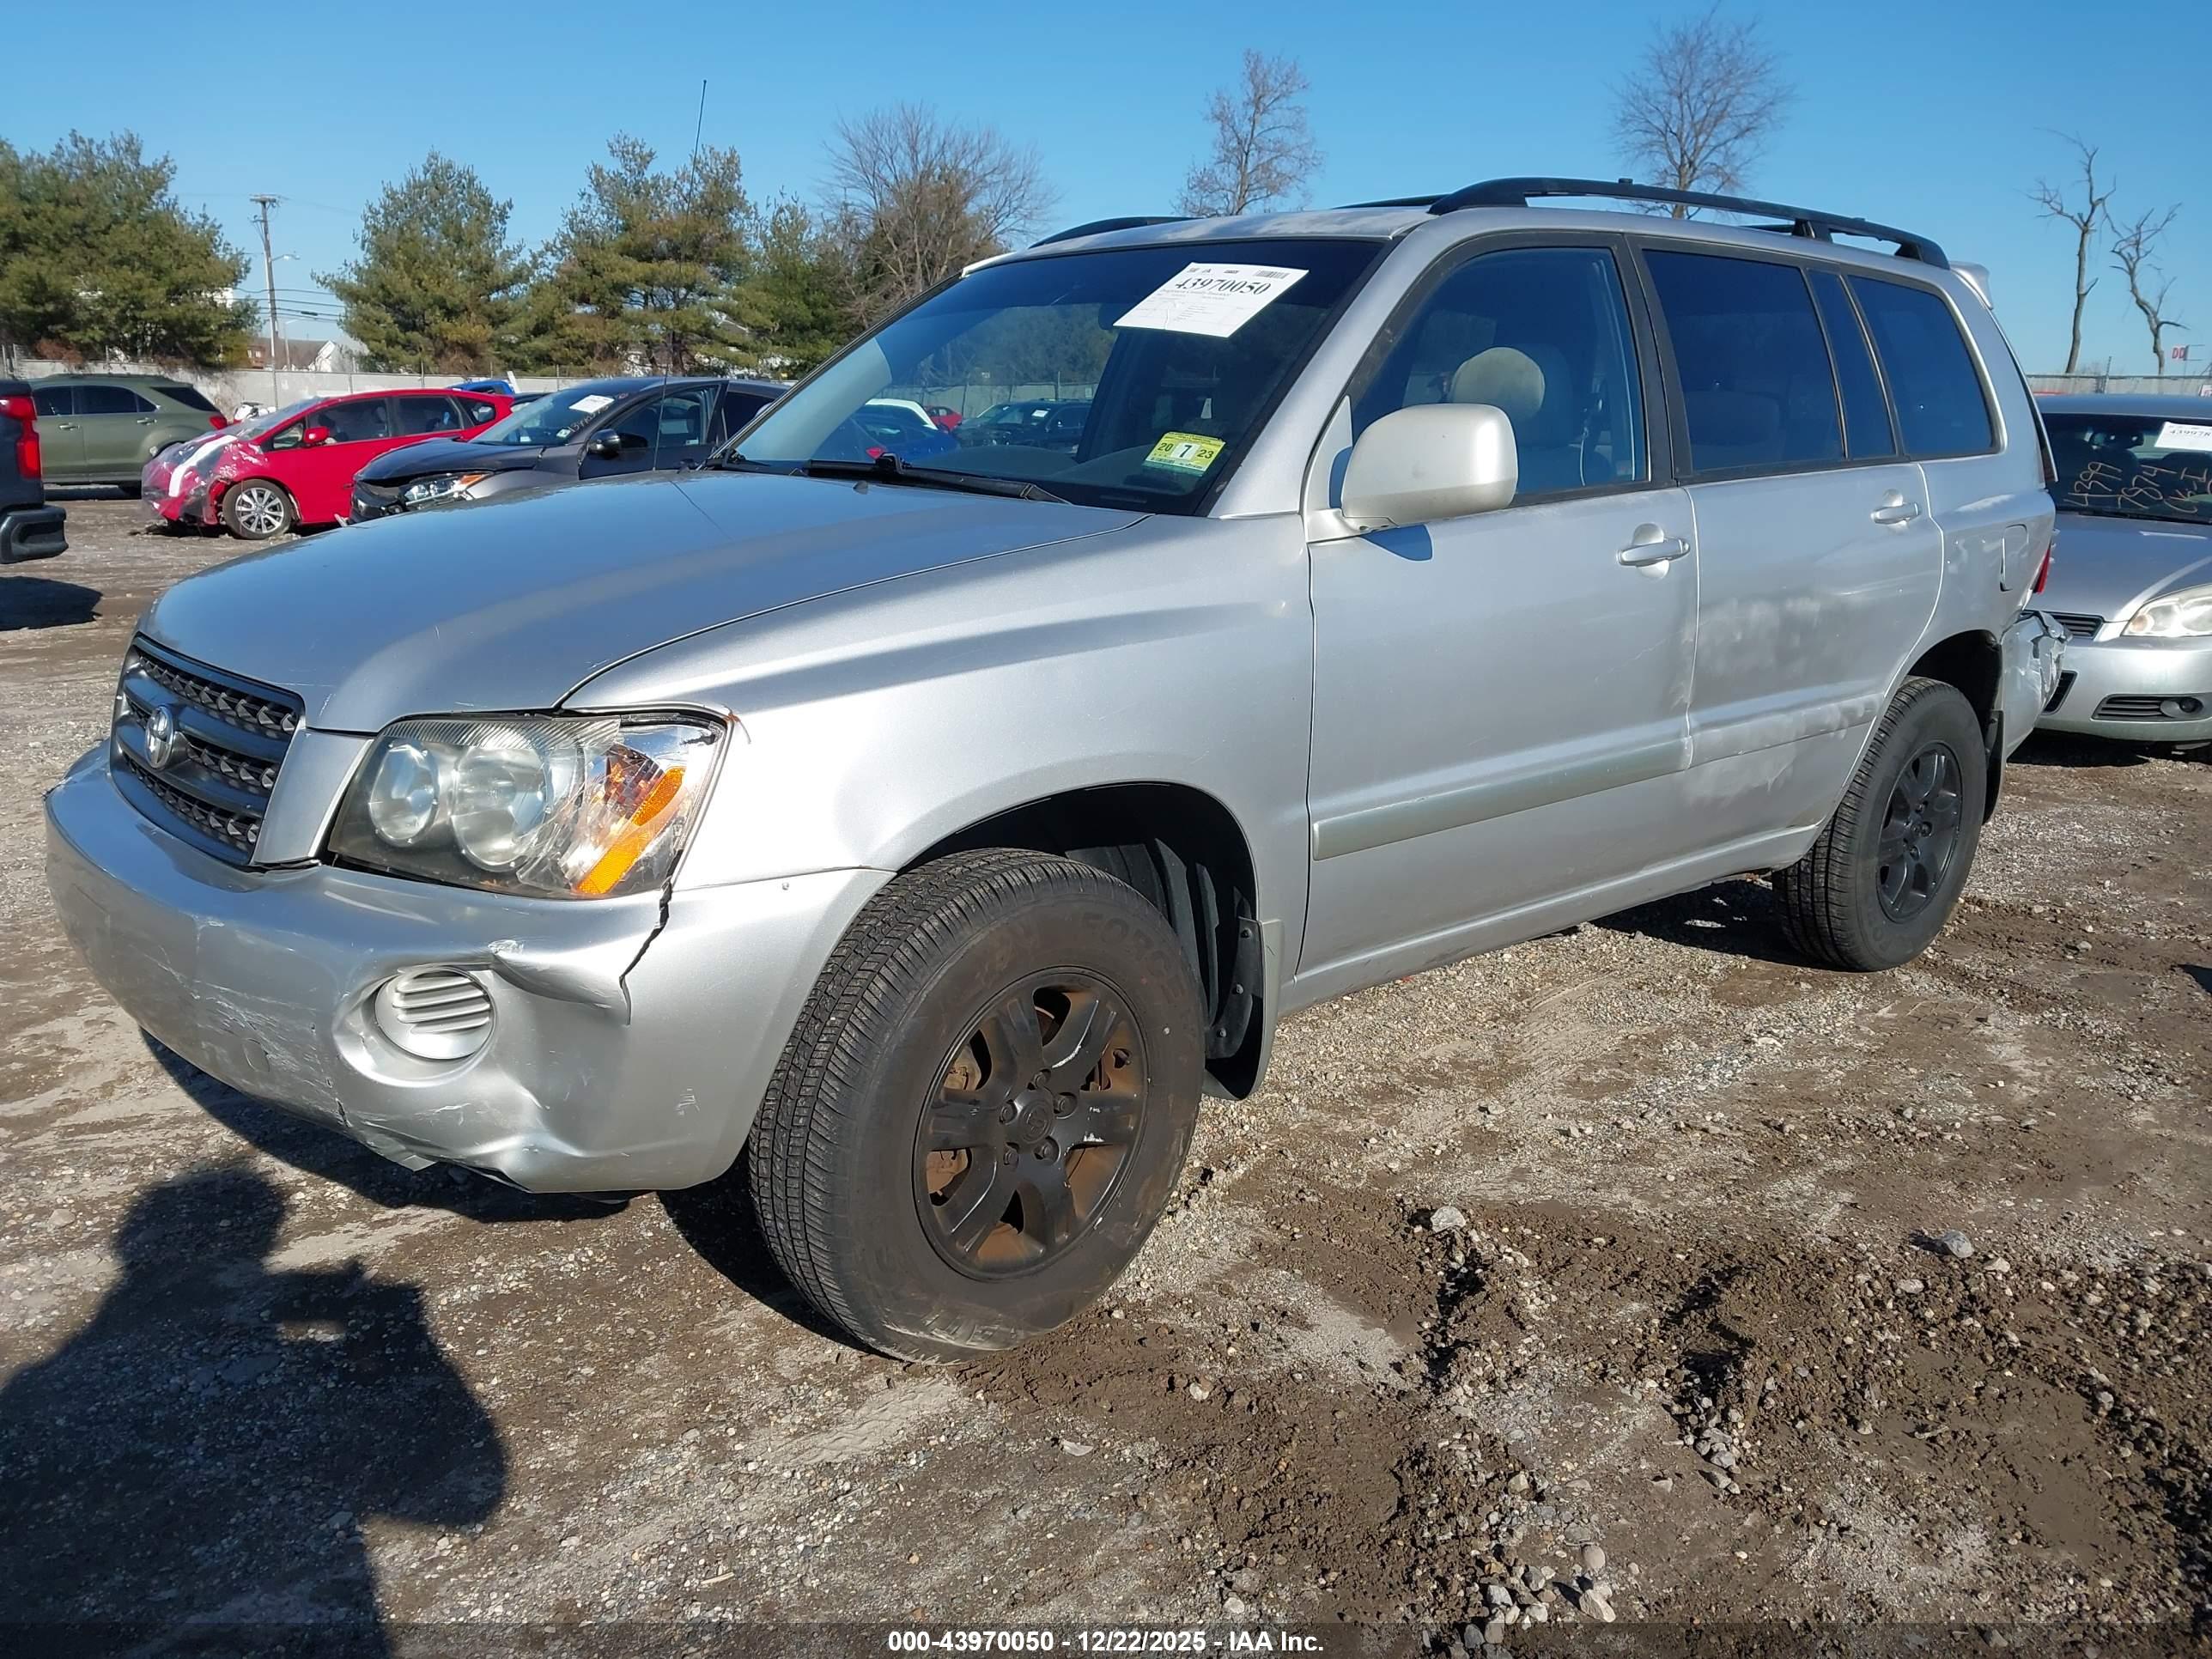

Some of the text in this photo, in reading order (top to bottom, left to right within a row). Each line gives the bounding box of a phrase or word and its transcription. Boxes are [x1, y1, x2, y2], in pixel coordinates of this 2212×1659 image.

[1175, 277, 1272, 295] 43970050
[1158, 442, 1214, 459] 20 7 23
